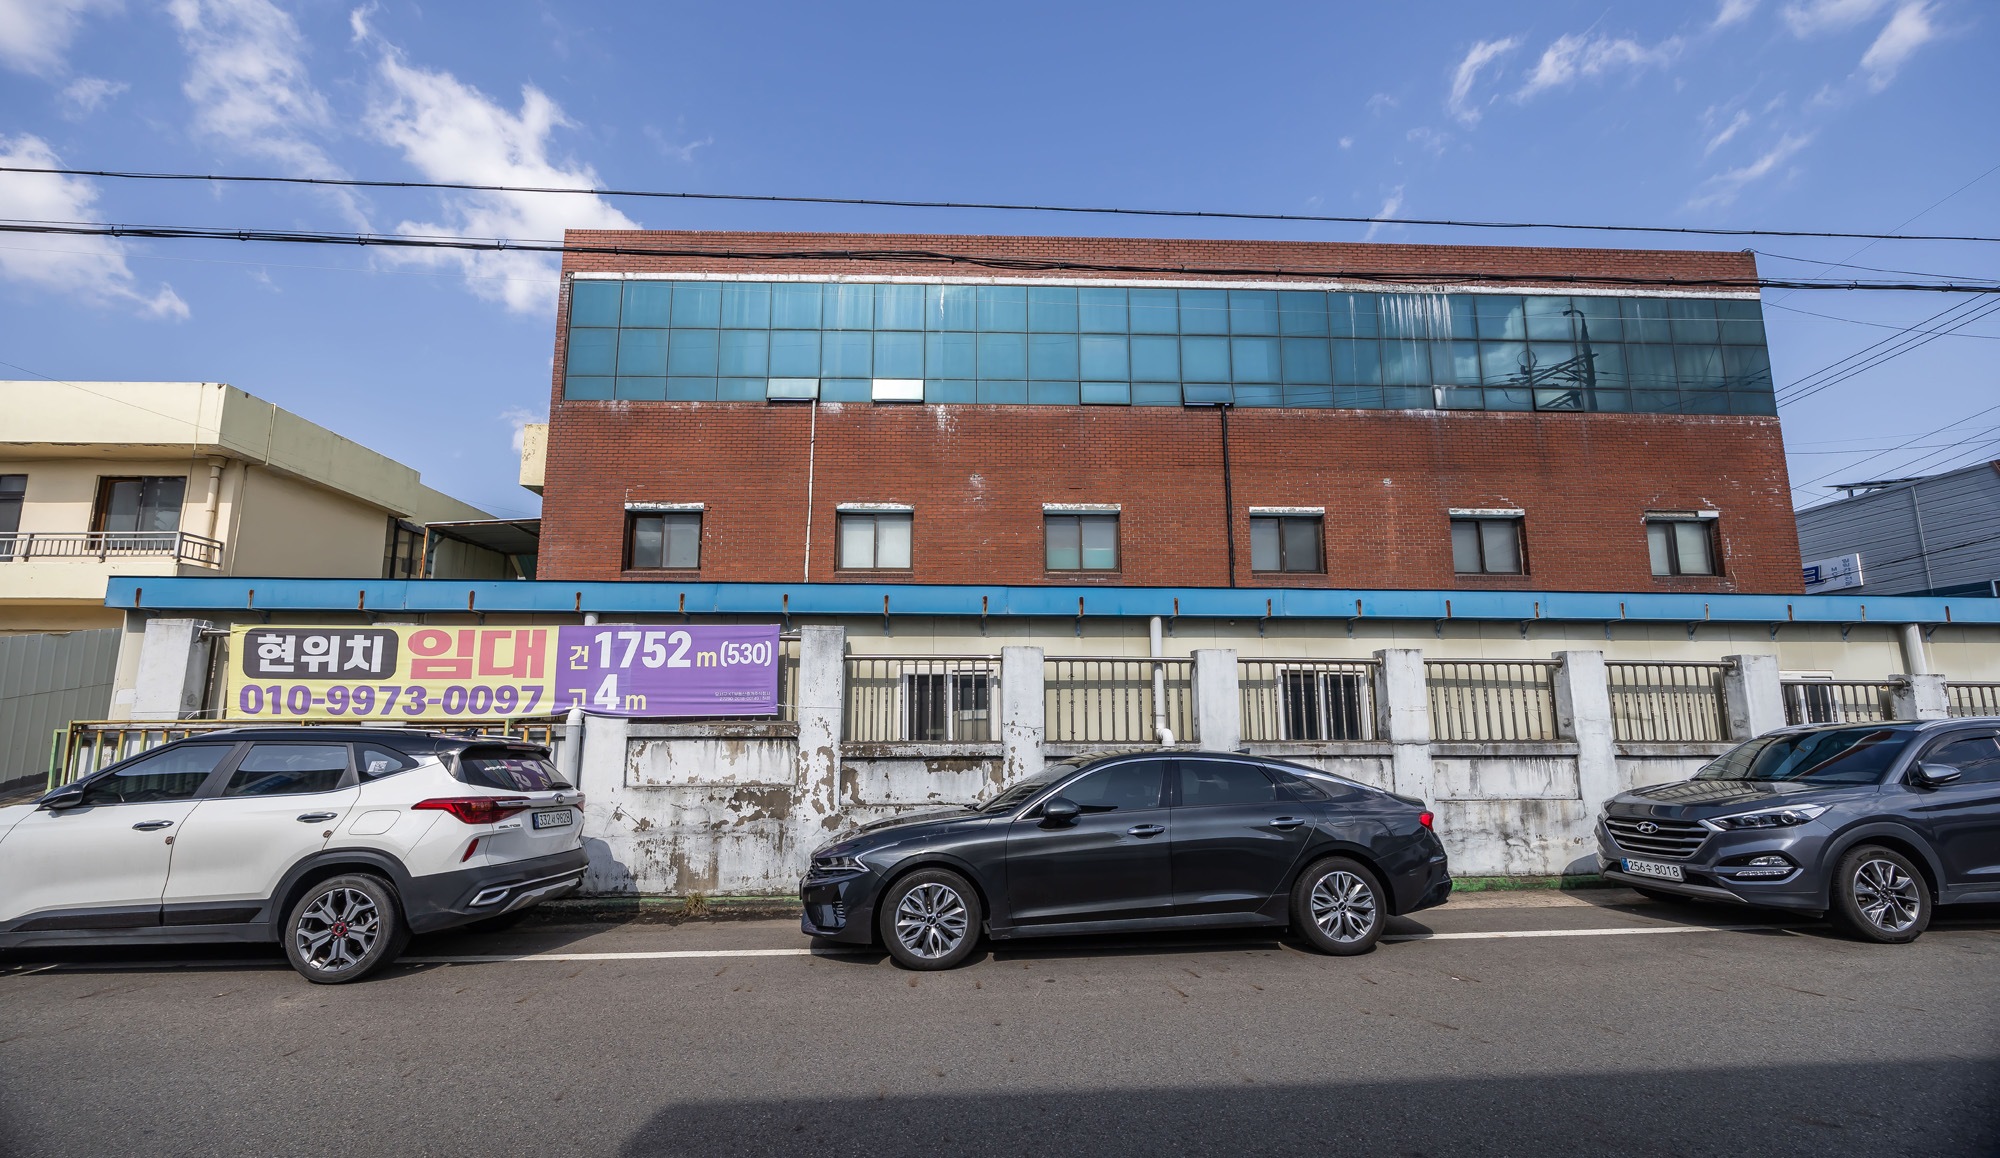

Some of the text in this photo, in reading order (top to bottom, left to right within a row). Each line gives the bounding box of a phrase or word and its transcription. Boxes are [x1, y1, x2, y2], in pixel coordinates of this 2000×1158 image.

[257, 629, 548, 680] 현위치 임대
[569, 645, 589, 670] 건
[594, 630, 692, 668] 1752
[720, 641, 772, 667] (530)
[239, 684, 544, 716] 010-9973-0097
[565, 674, 646, 710] 고 4 m
